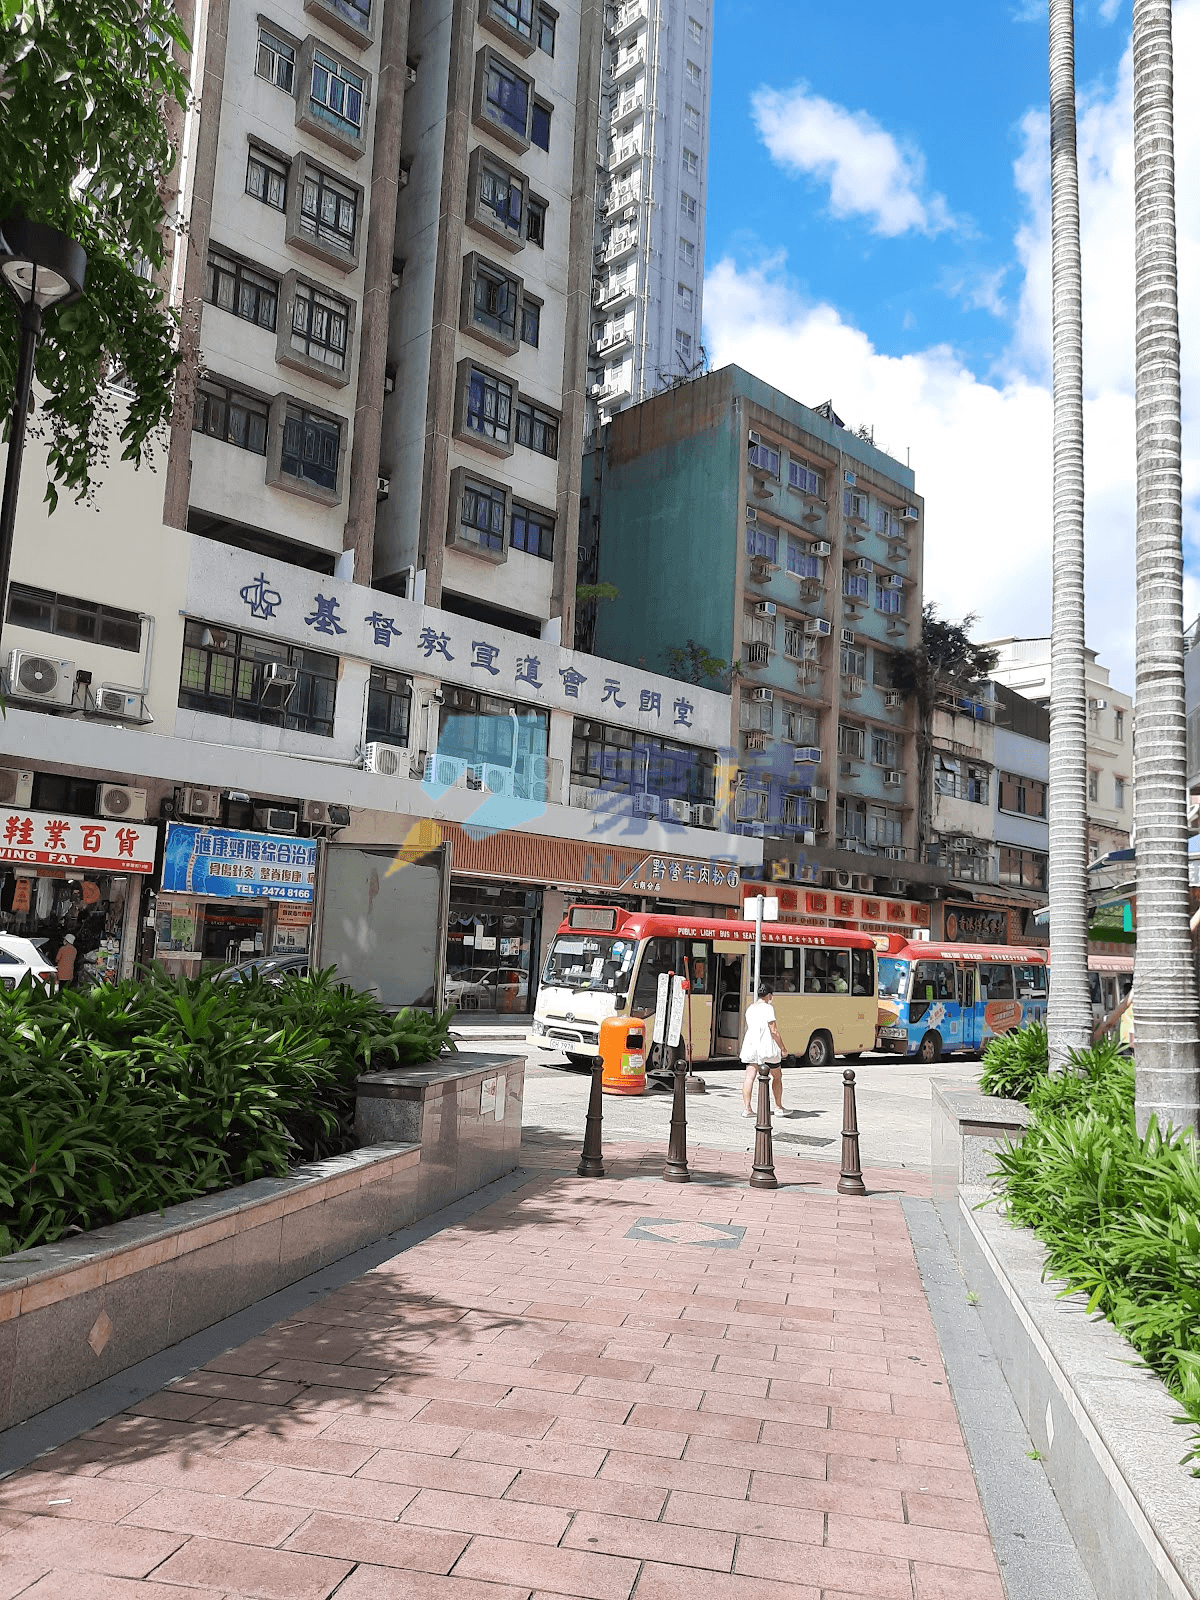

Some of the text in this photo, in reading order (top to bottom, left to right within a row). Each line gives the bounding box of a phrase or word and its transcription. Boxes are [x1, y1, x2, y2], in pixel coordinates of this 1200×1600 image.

[2, 815, 140, 858] 鞋業百貨
[48, 853, 79, 865] FAT
[262, 885, 285, 897] 2474
[287, 887, 310, 898] 8166
[677, 927, 697, 936] PUBLIC
[700, 929, 716, 938] LIGHT
[719, 930, 730, 938] BUS
